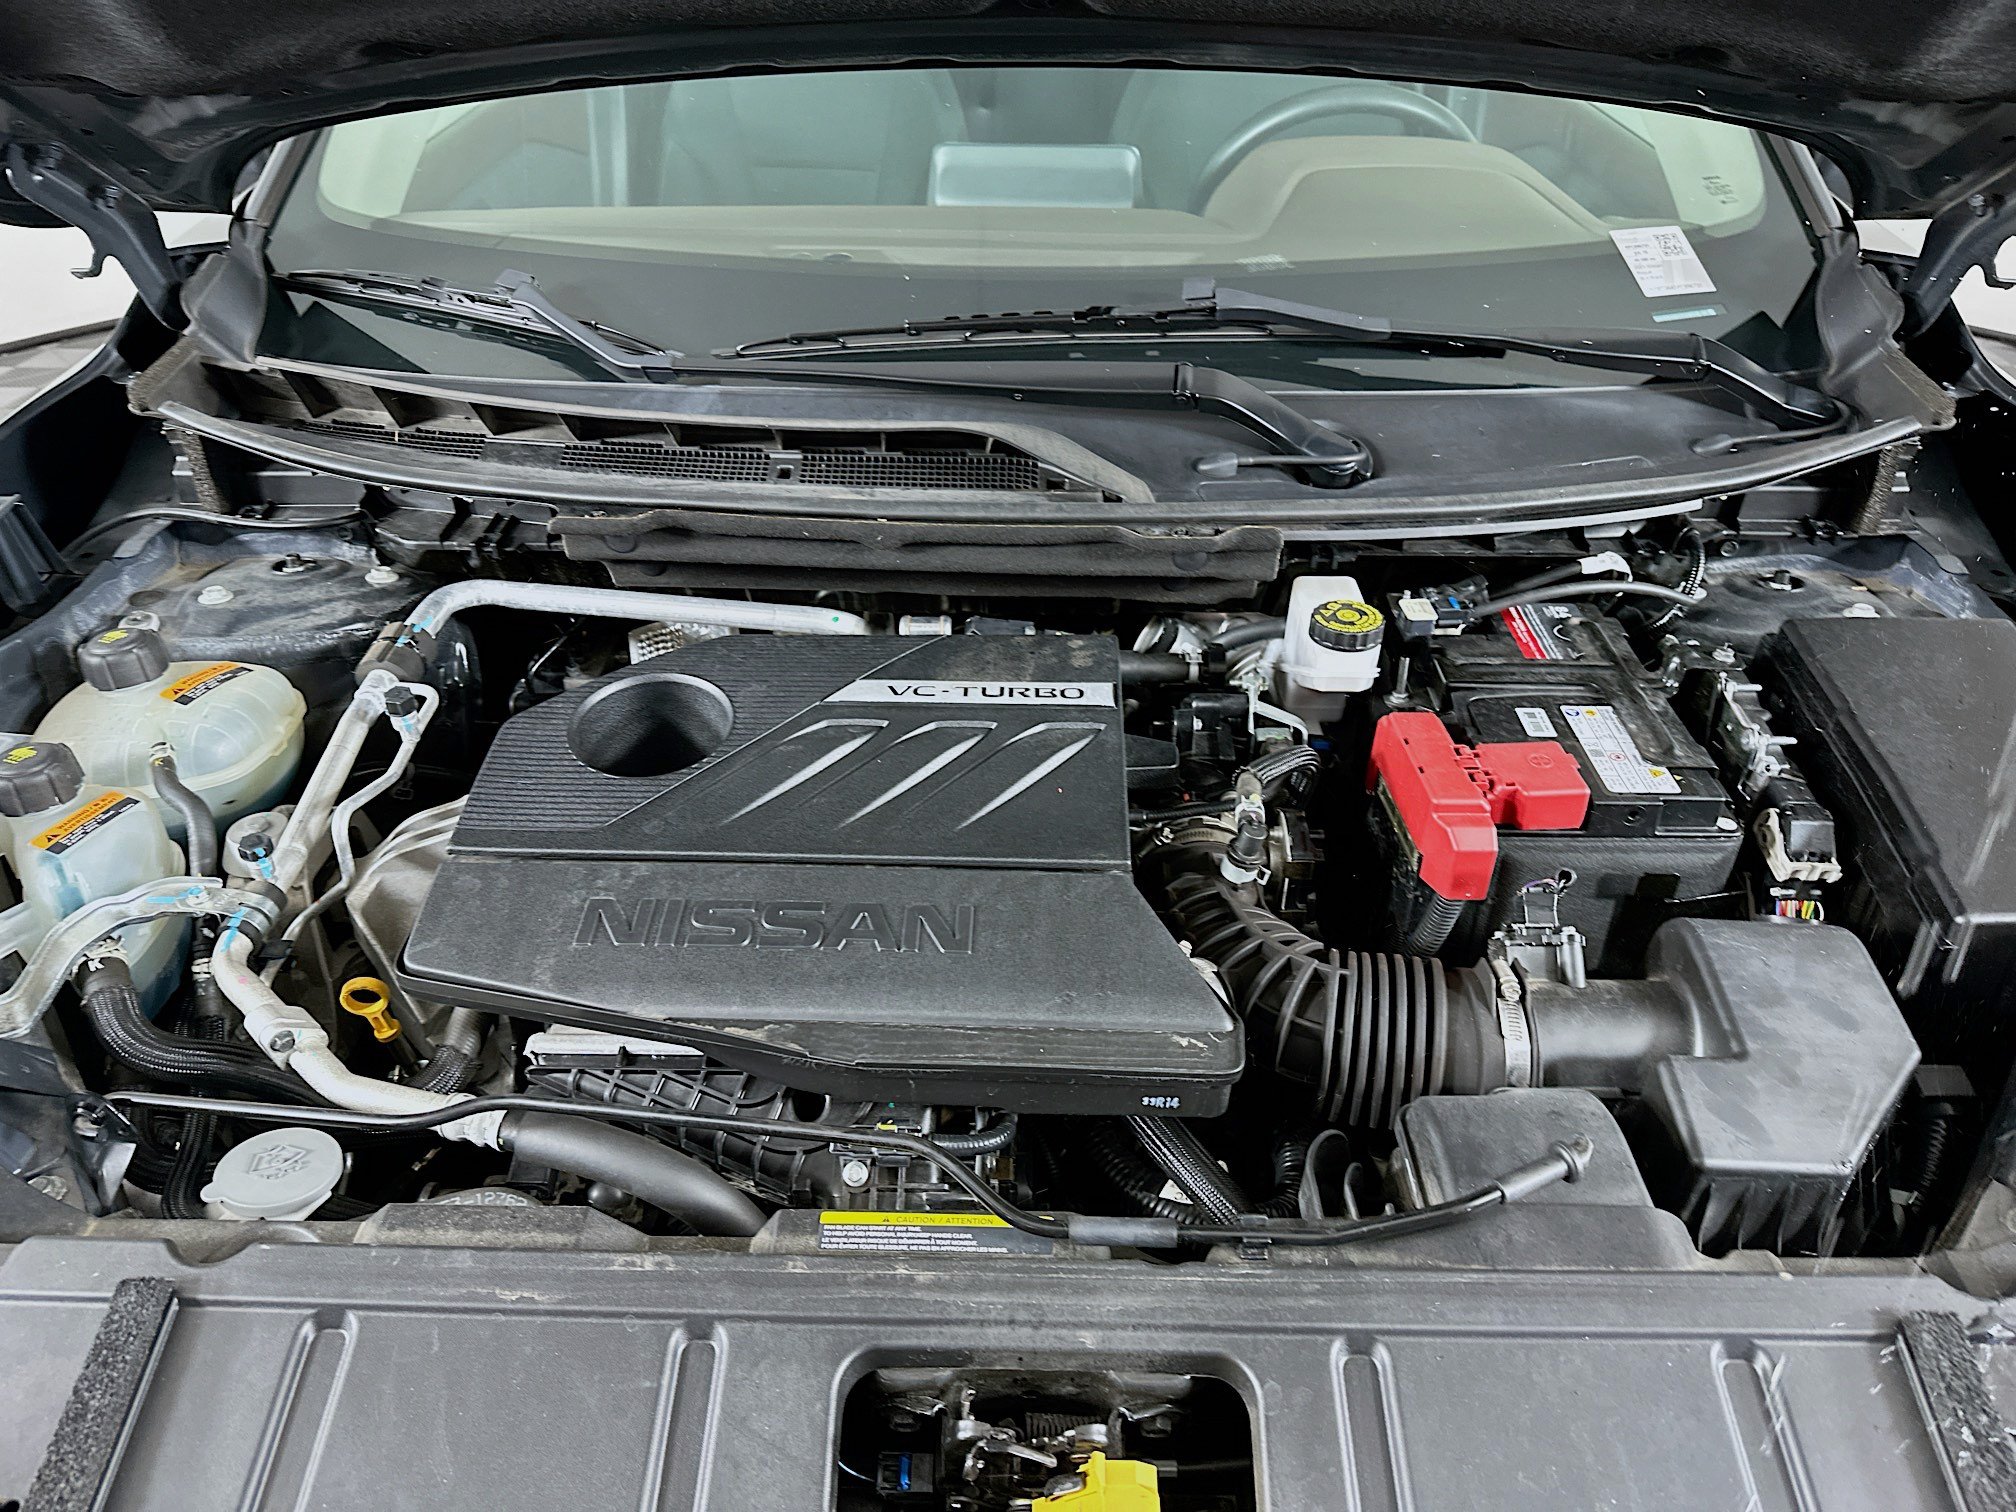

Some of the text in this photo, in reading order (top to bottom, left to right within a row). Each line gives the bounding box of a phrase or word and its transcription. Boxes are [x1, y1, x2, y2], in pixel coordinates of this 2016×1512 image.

[887, 685, 1085, 699] VC-TURBO
[572, 896, 974, 955] NISSAN
[945, 1217, 994, 1225] ATTENTION
